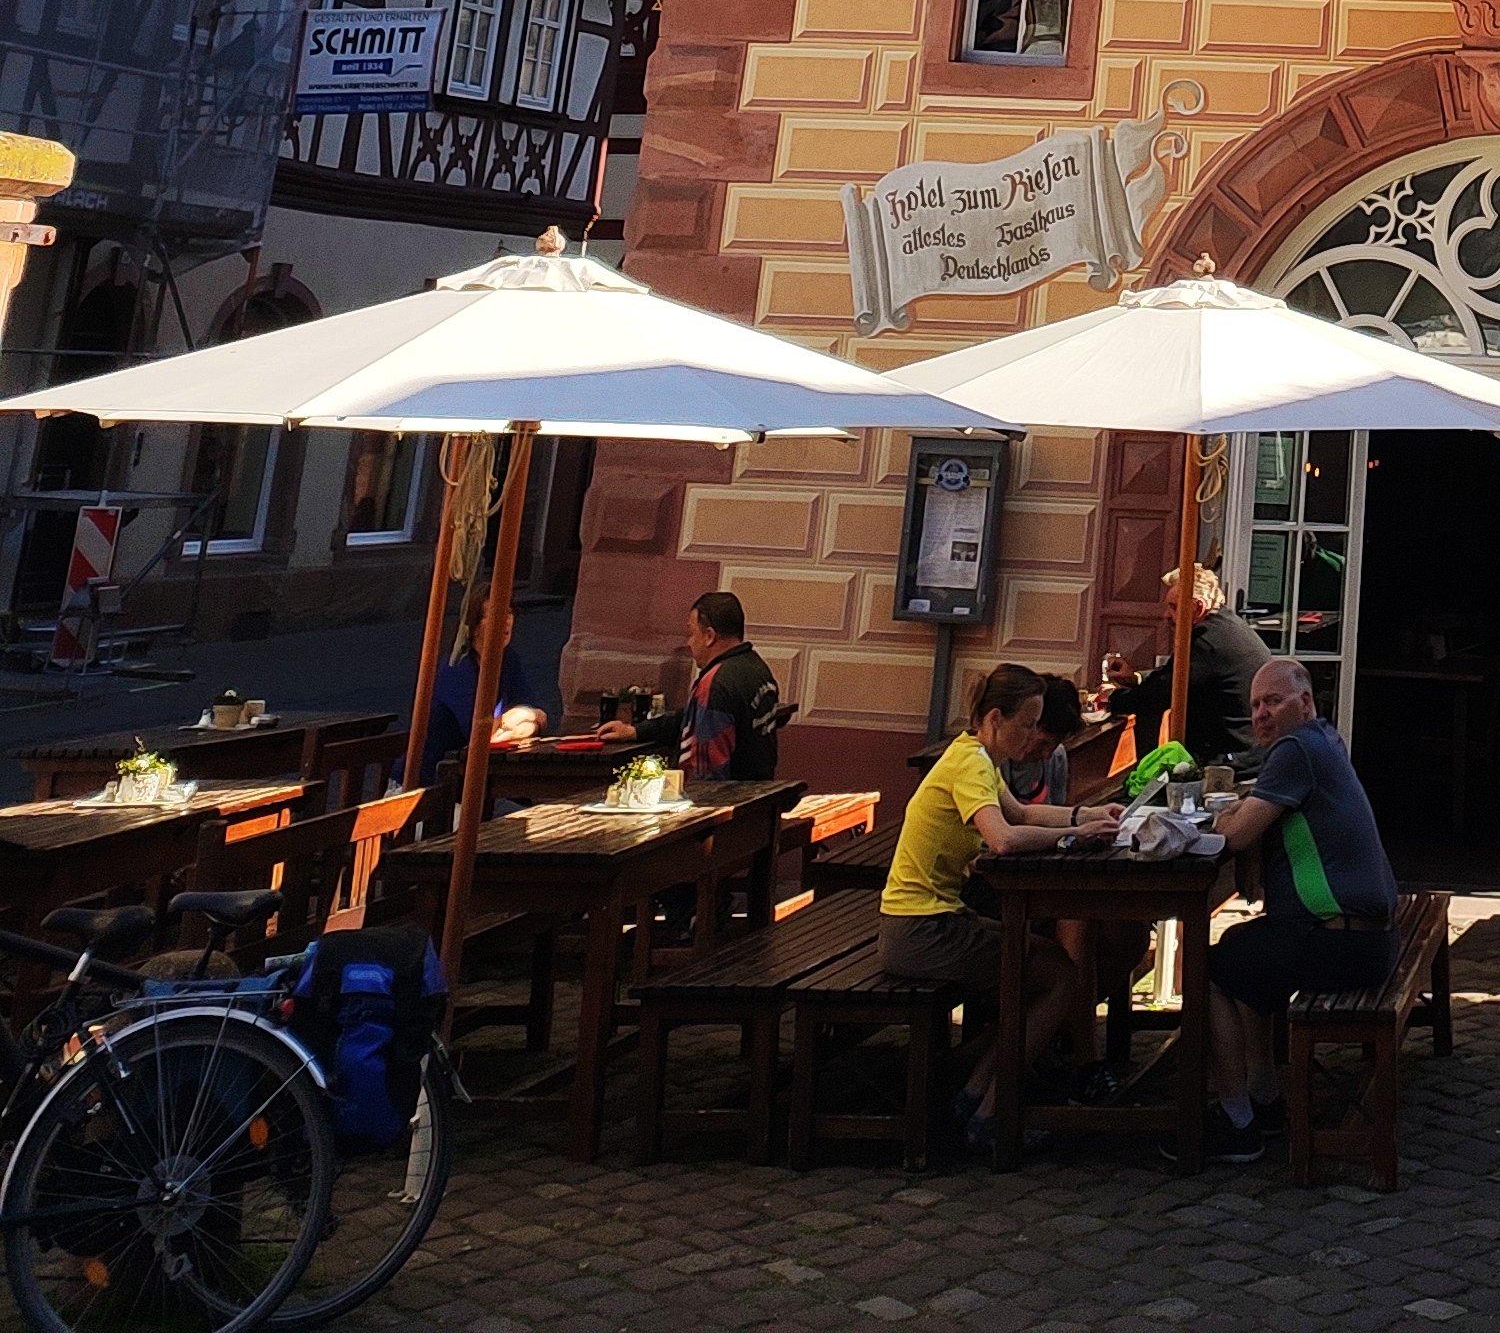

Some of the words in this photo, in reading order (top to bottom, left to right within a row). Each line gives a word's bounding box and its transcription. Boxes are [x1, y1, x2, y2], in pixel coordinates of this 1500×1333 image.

[314, 13, 362, 23] GESTALTEN
[364, 13, 383, 22] UND
[385, 11, 430, 22] ERHALTEN
[309, 26, 427, 56] SCHMITT
[341, 63, 359, 72] seit
[363, 62, 384, 71] 1934
[885, 175, 945, 229] Hotel
[950, 187, 1002, 216] zum
[996, 203, 1076, 248] Gasthaus
[940, 244, 1051, 282] Deutschlands
